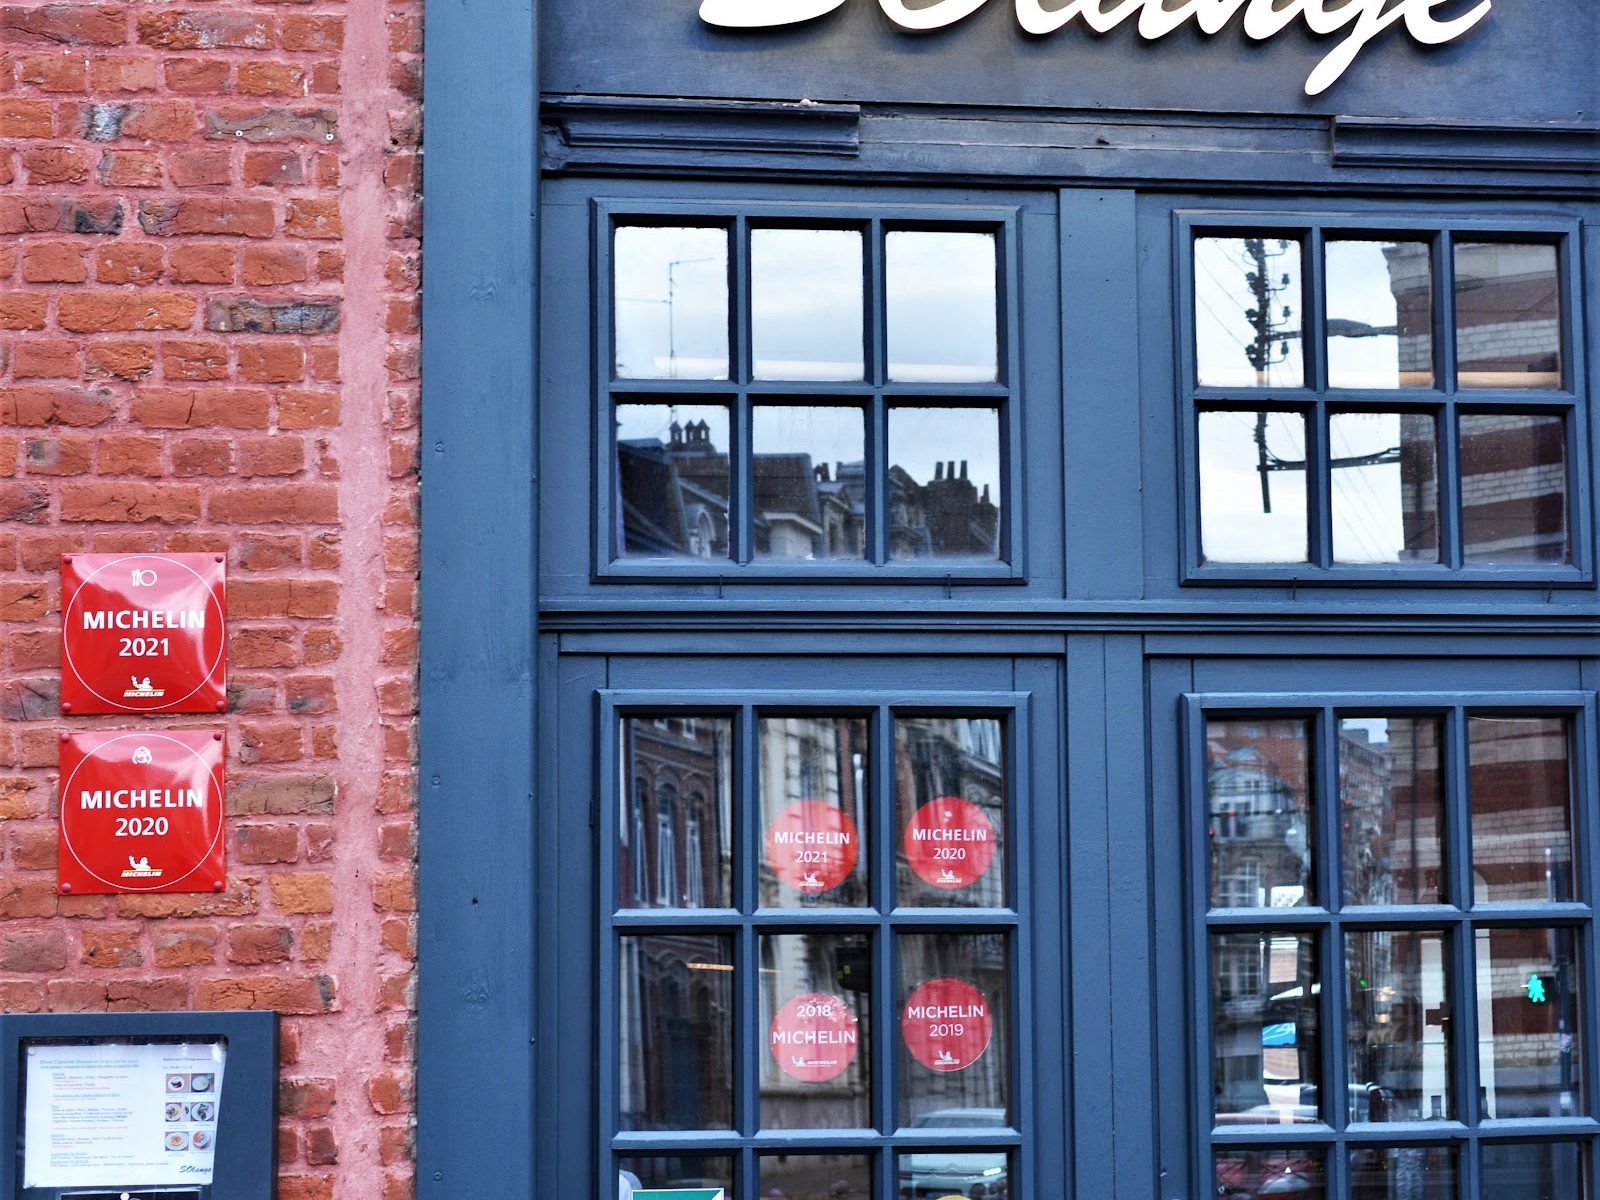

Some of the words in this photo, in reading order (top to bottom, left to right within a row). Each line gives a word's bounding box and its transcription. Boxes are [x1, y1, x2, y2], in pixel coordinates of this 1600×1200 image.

[83, 610, 205, 629] MICHELIN
[118, 637, 169, 657] 2021
[81, 789, 203, 809] MICHELIN
[114, 817, 169, 837] 2020
[774, 831, 850, 845] MICHELIN
[912, 828, 987, 842] MICHELIN
[795, 850, 828, 864] 2021
[933, 847, 966, 861] 2020
[796, 1004, 832, 1018] 2018
[908, 1005, 984, 1019] MICHELIN
[929, 1023, 964, 1037] 2019
[772, 1030, 856, 1045] MICHELIN
[179, 1165, 212, 1175] SOlange
